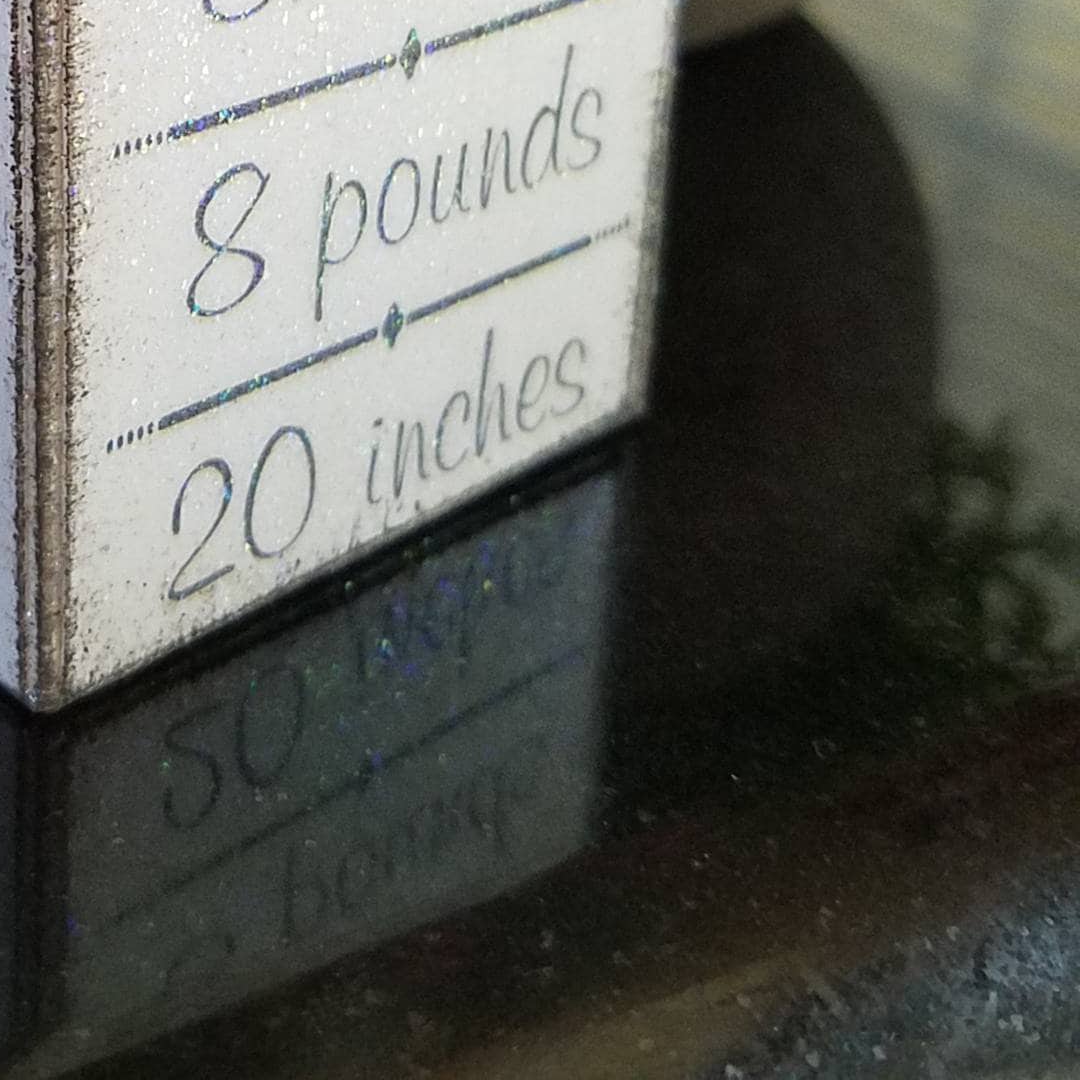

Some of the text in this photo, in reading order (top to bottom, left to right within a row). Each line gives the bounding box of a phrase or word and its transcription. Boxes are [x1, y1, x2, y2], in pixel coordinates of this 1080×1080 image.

[186, 44, 603, 321] 8 pounds
[167, 327, 587, 600] 20 inches
